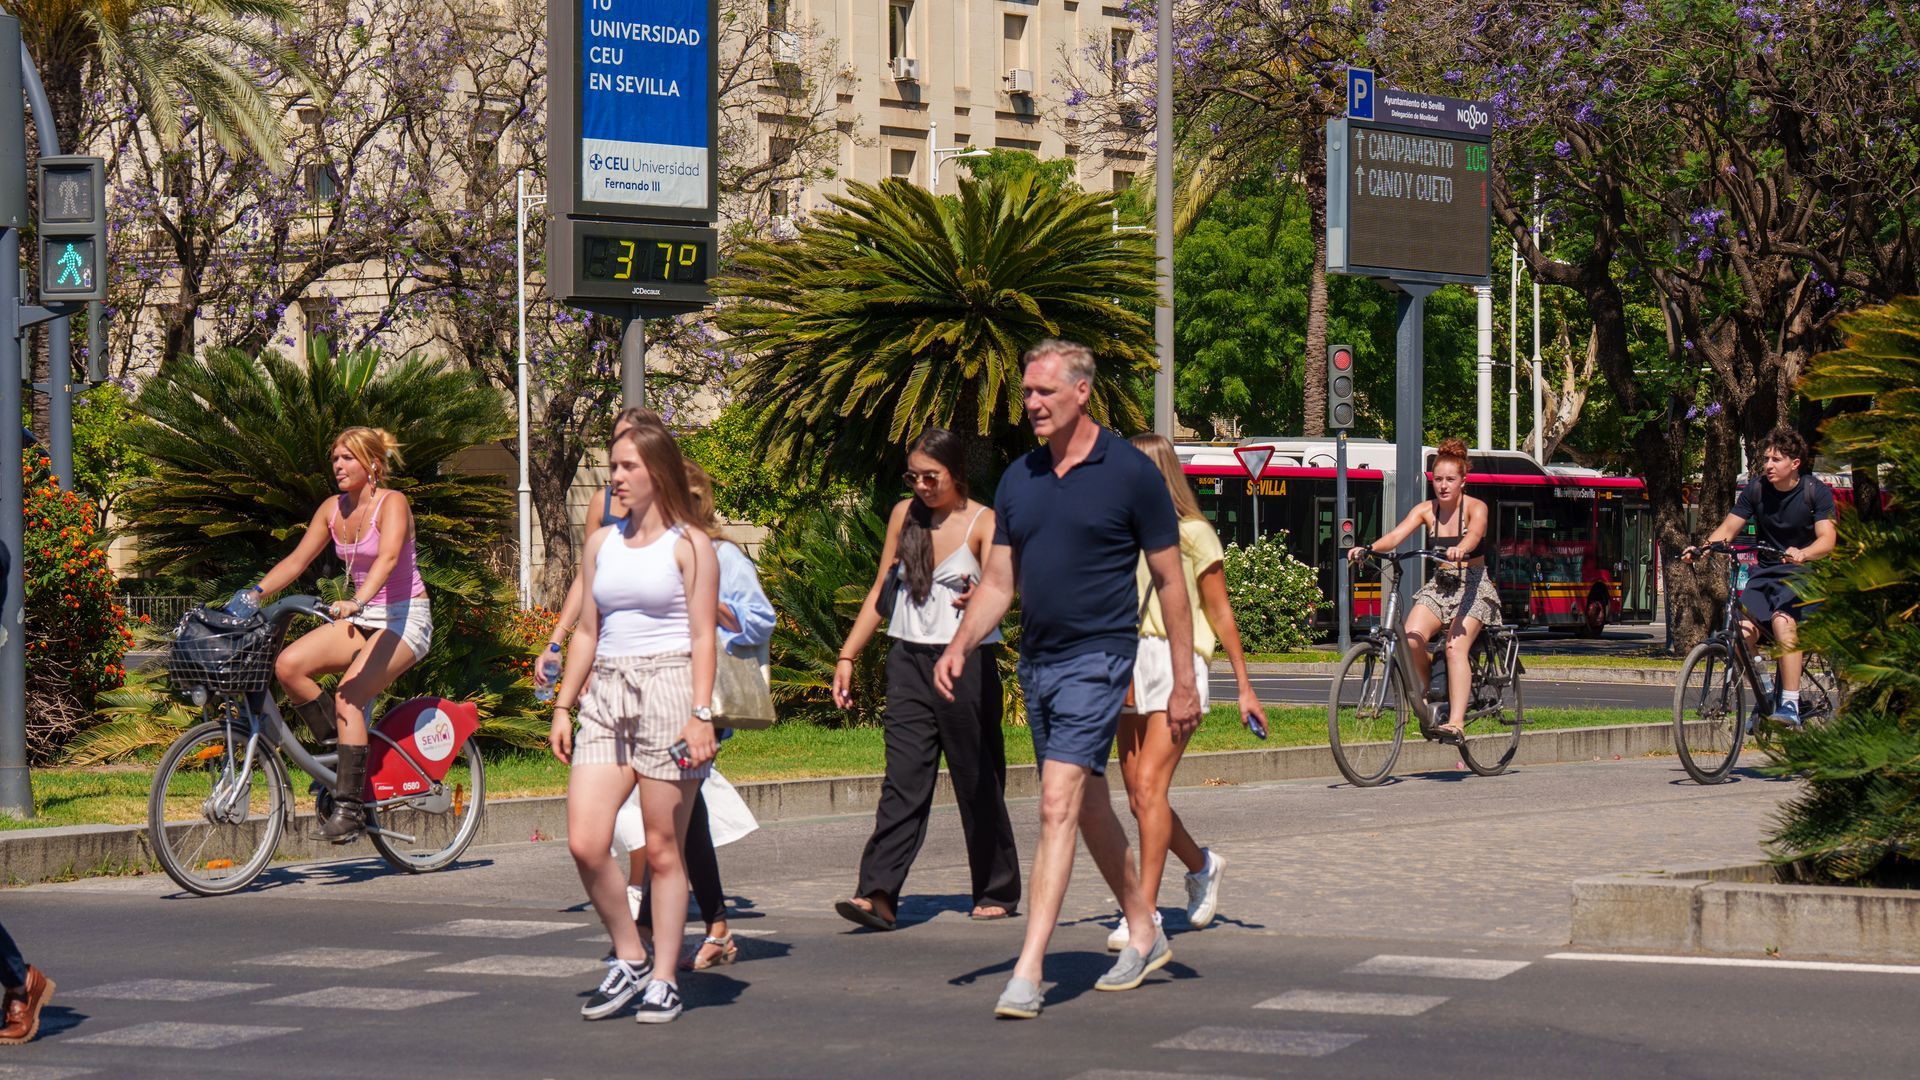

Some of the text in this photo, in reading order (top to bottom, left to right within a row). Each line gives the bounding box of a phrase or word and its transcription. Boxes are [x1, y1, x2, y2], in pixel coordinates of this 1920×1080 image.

[590, 19, 700, 46] UNIVERSIDAD
[589, 46, 623, 65] CEU
[589, 72, 681, 97] EN SEVILLA
[1354, 78, 1367, 109] P
[1384, 95, 1445, 111] Ayuntamiento de Sevilla
[1368, 133, 1487, 172] CAMPAMENTO 105
[605, 156, 700, 177] CEU Universidad
[605, 177, 661, 192] Fernando III
[1368, 168, 1401, 198] CANO
[1404, 172, 1413, 199] Y
[1416, 174, 1453, 203] CUETO
[631, 287, 661, 296] JCDecaux
[402, 781, 420, 791] 0580
